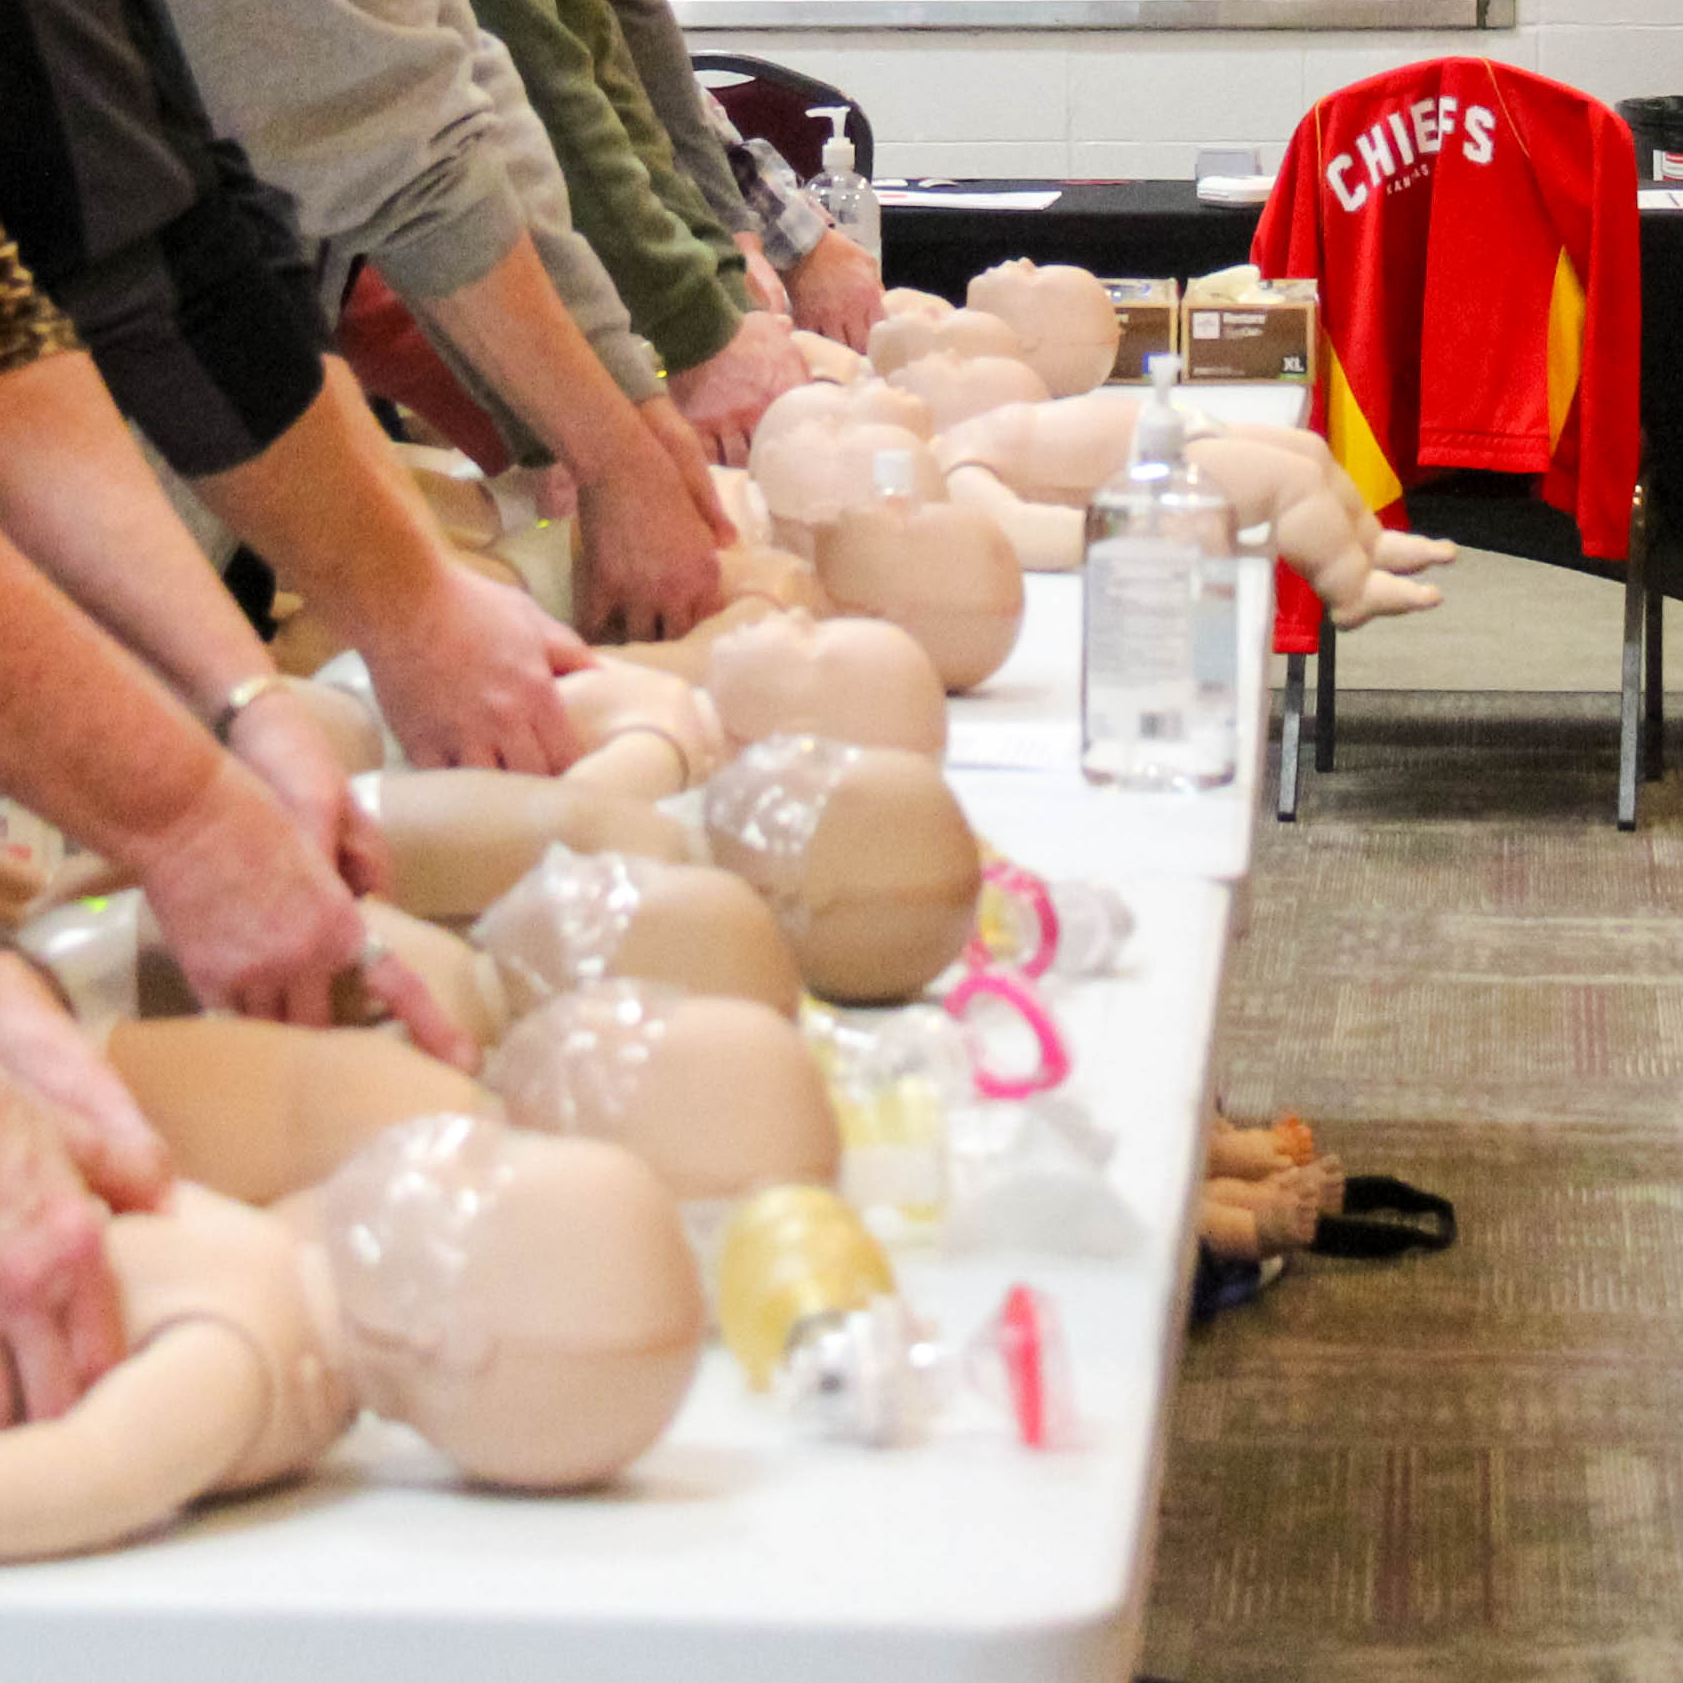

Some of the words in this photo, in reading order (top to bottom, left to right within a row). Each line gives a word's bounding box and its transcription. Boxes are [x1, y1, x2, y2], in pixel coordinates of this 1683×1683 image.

[1326, 96, 1495, 212] CHIEFS
[1386, 164, 1430, 196] KANAS
[1282, 356, 1305, 372] XL
